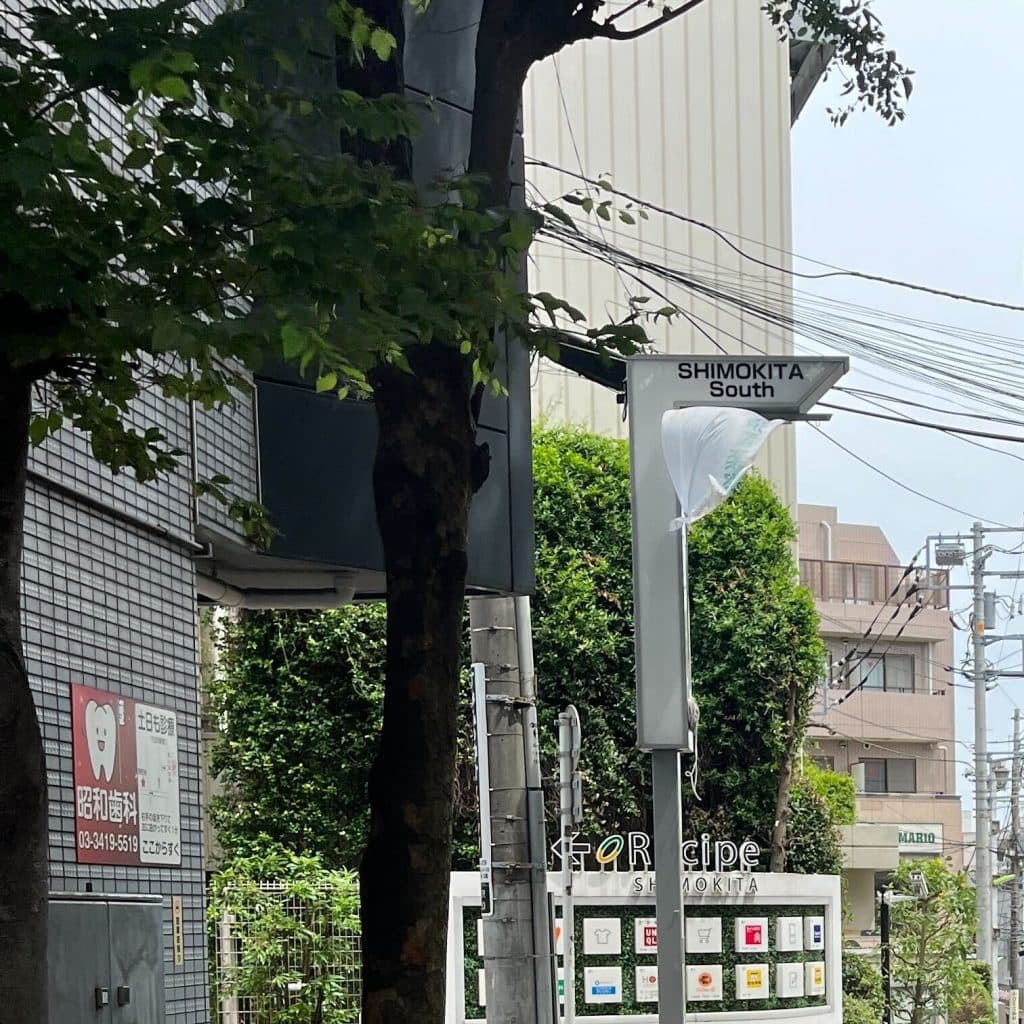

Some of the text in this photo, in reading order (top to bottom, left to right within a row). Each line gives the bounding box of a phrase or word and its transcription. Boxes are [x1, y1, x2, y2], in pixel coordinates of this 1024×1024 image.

[678, 363, 804, 380] SHIMOKITA
[709, 381, 775, 398] South
[77, 785, 138, 825] 昭和歯科
[79, 831, 138, 853] 03-3419-5519
[898, 832, 936, 844] MARIO
[628, 831, 761, 873] Rcipe
[634, 877, 759, 892] SHMOKITA
[645, 928, 657, 936] UN
